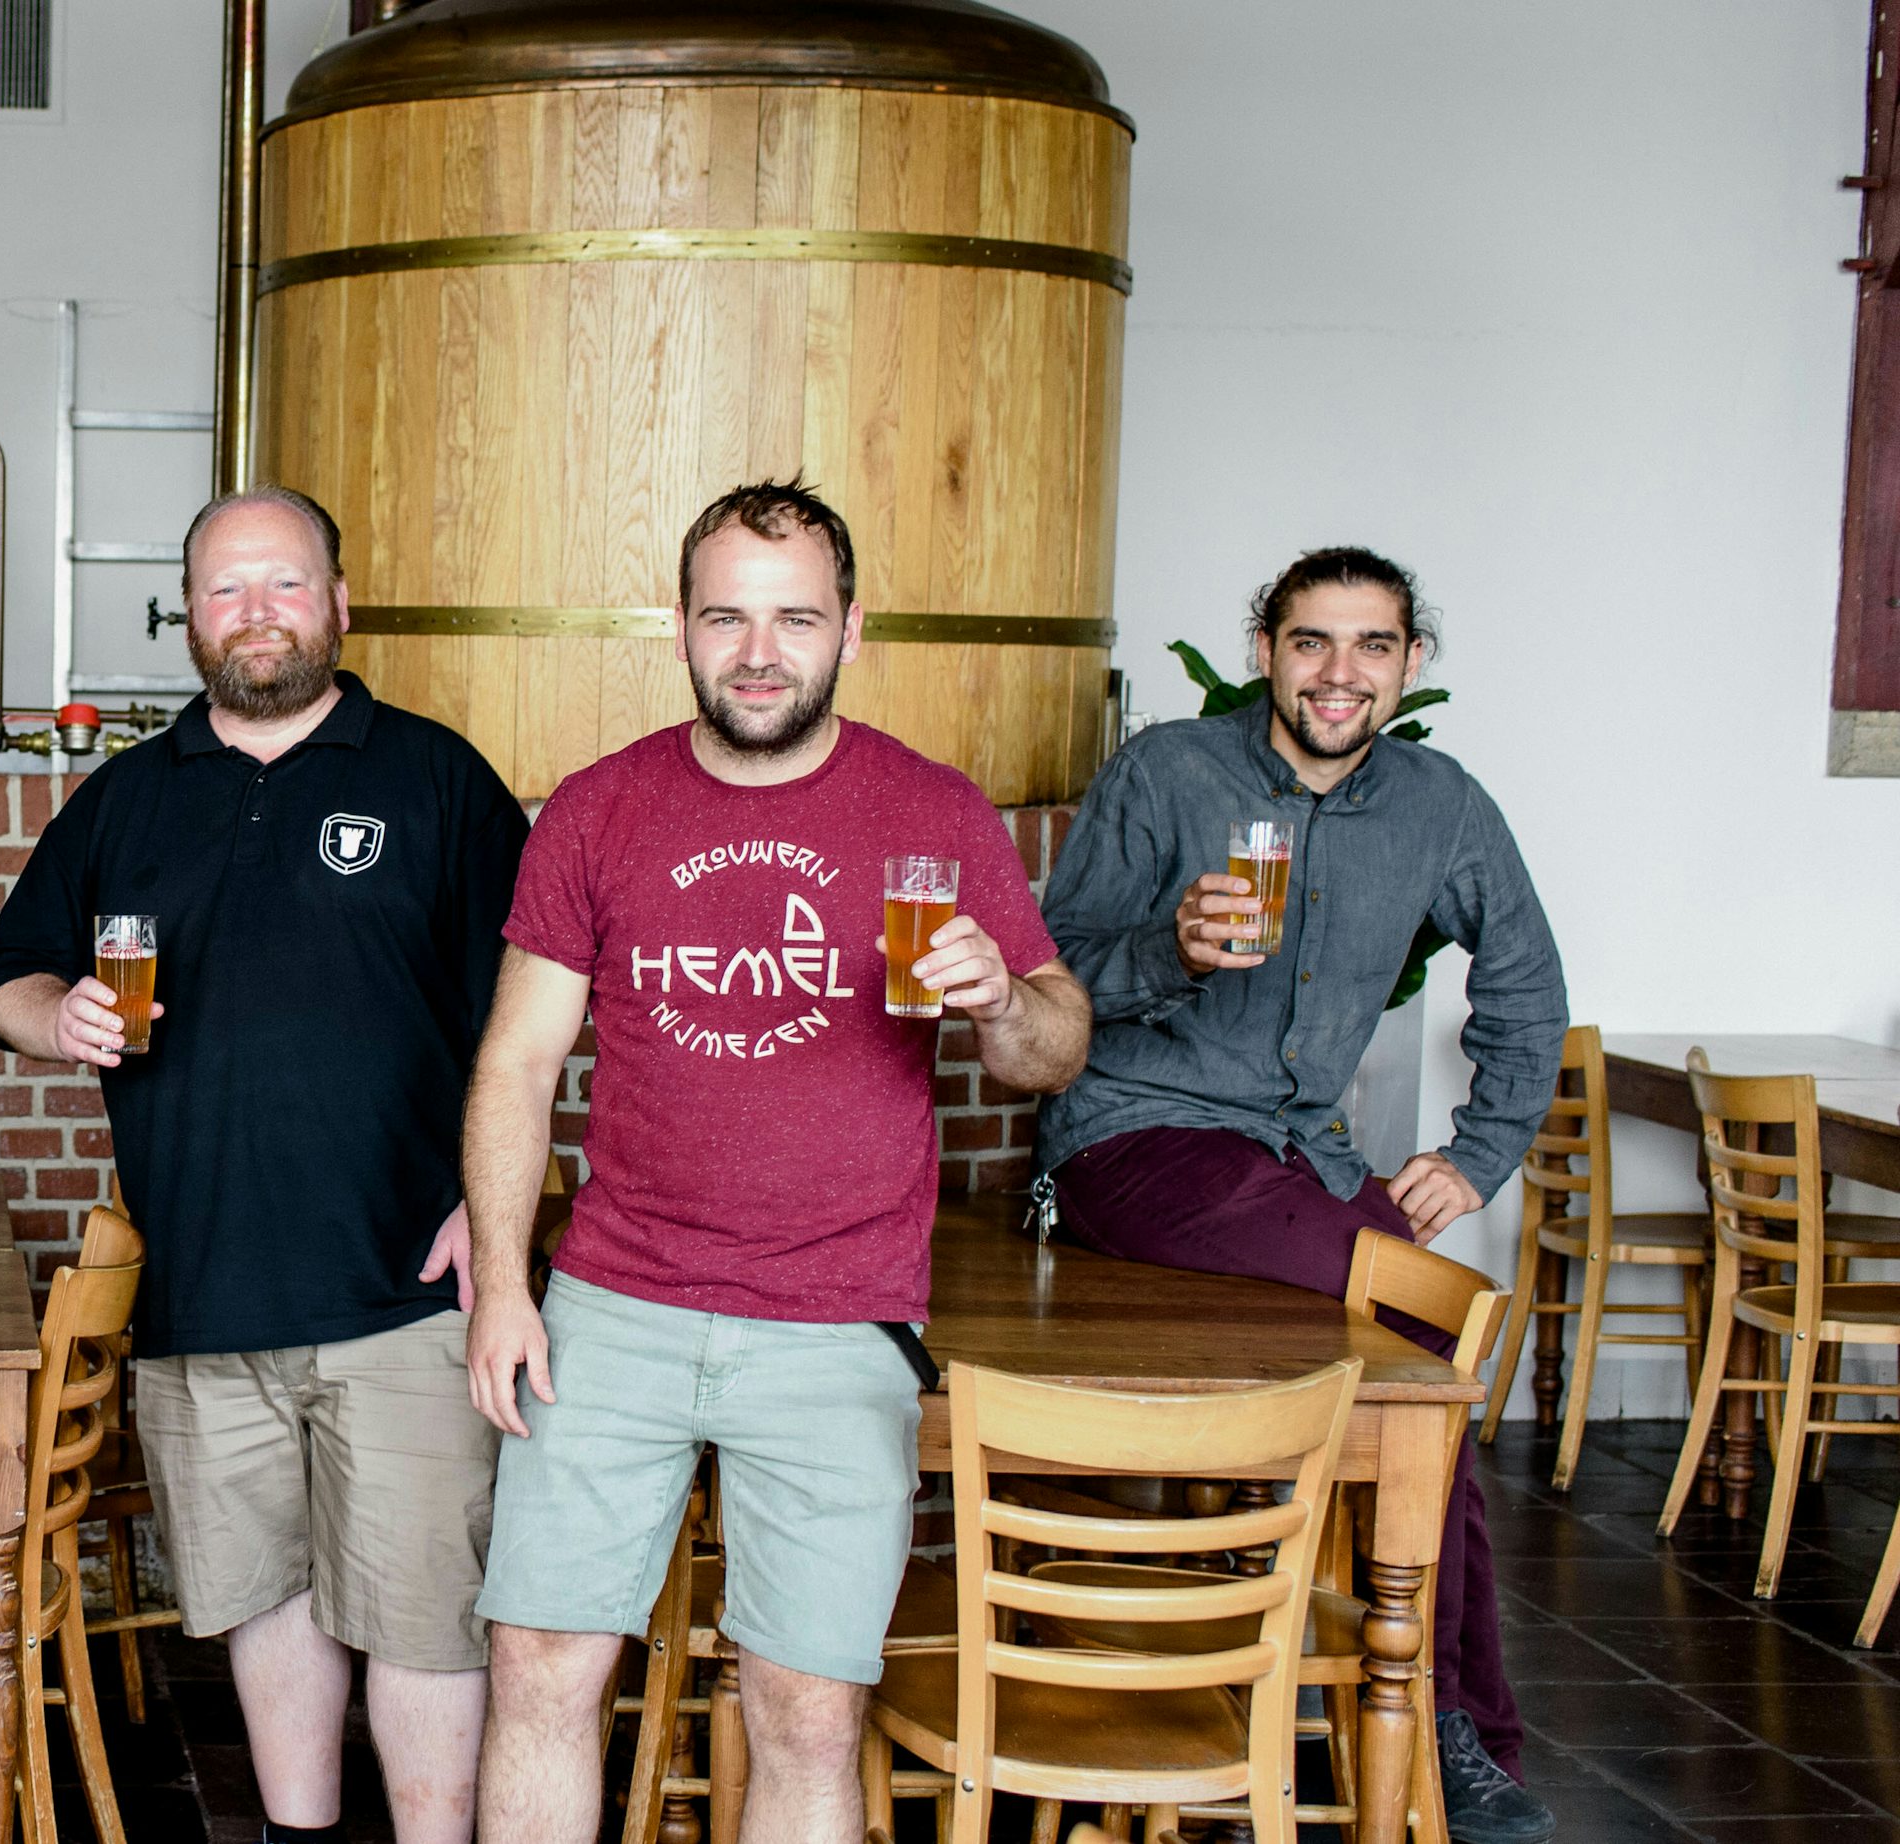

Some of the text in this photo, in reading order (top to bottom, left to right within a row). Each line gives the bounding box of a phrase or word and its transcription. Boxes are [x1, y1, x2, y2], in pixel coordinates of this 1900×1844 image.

[670, 840, 840, 890] BROUWERIJ
[631, 945, 855, 998] HEMEL
[649, 1001, 831, 1060] NIJMEGEN
